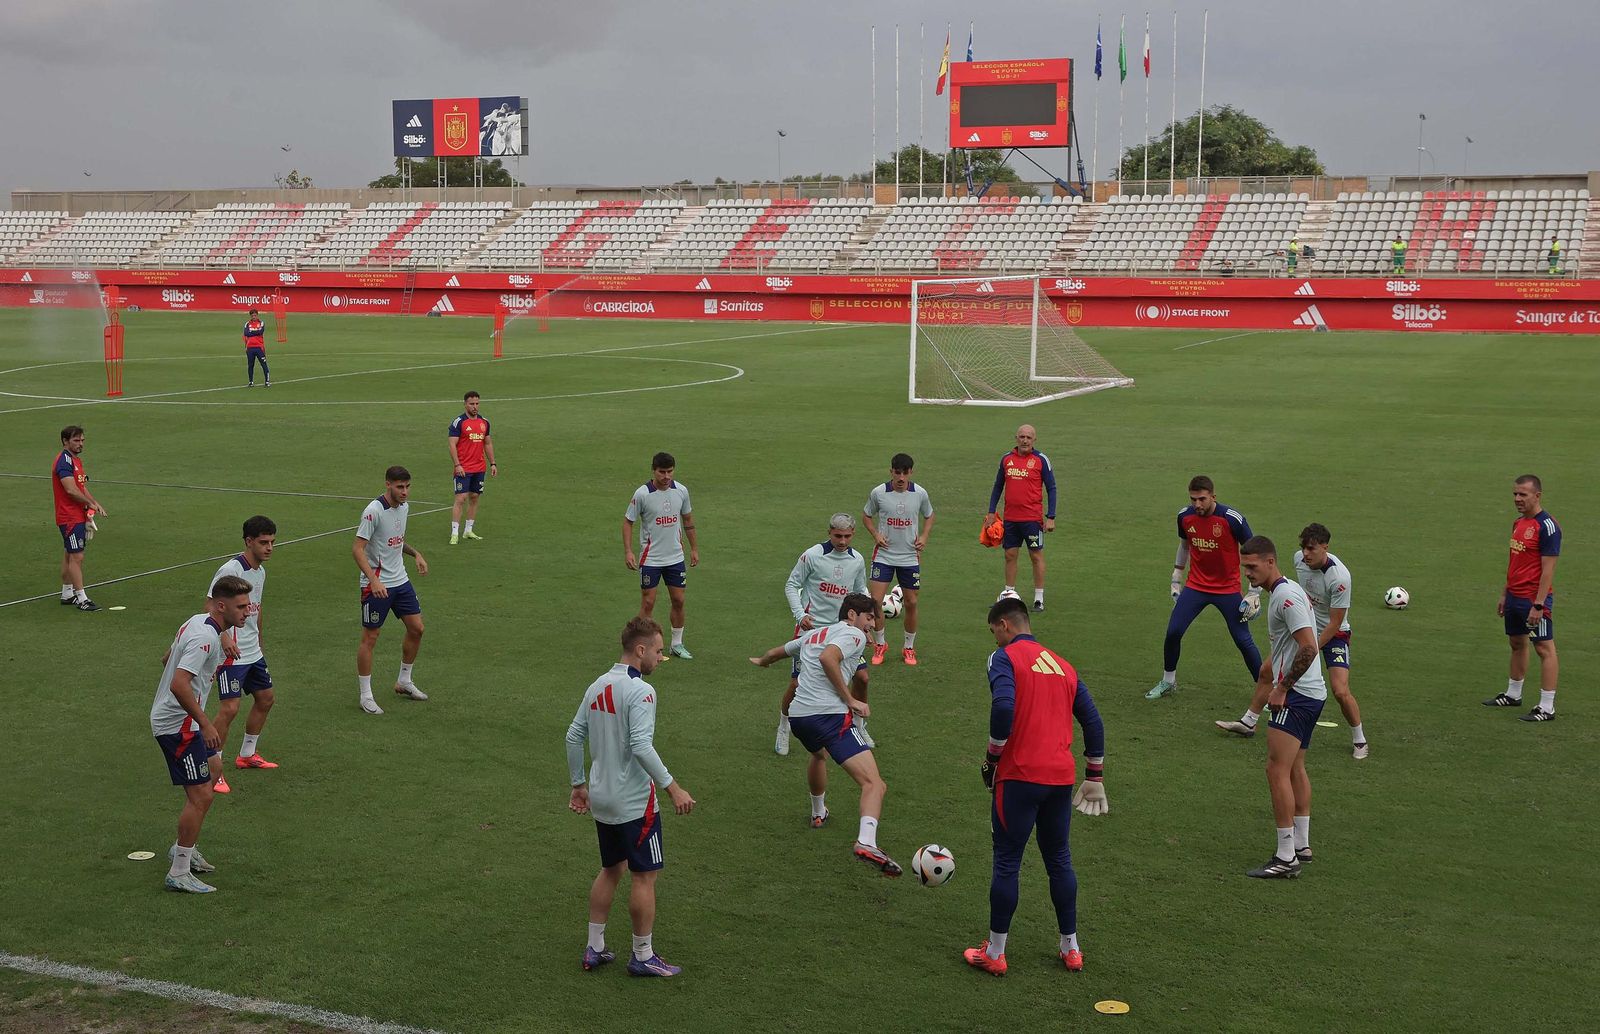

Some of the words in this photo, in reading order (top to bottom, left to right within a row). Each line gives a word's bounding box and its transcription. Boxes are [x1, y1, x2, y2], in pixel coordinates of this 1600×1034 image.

[232, 293, 260, 306] Sangre
[261, 294, 270, 304] de
[829, 299, 902, 308] SELECCIÓN
[983, 302, 1000, 310] DE
[720, 300, 764, 312] Sanitas
[919, 311, 963, 320] SUB-21
[1200, 309, 1230, 317] FRONT
[1516, 309, 1566, 326] Sangre
[1568, 311, 1584, 323] de
